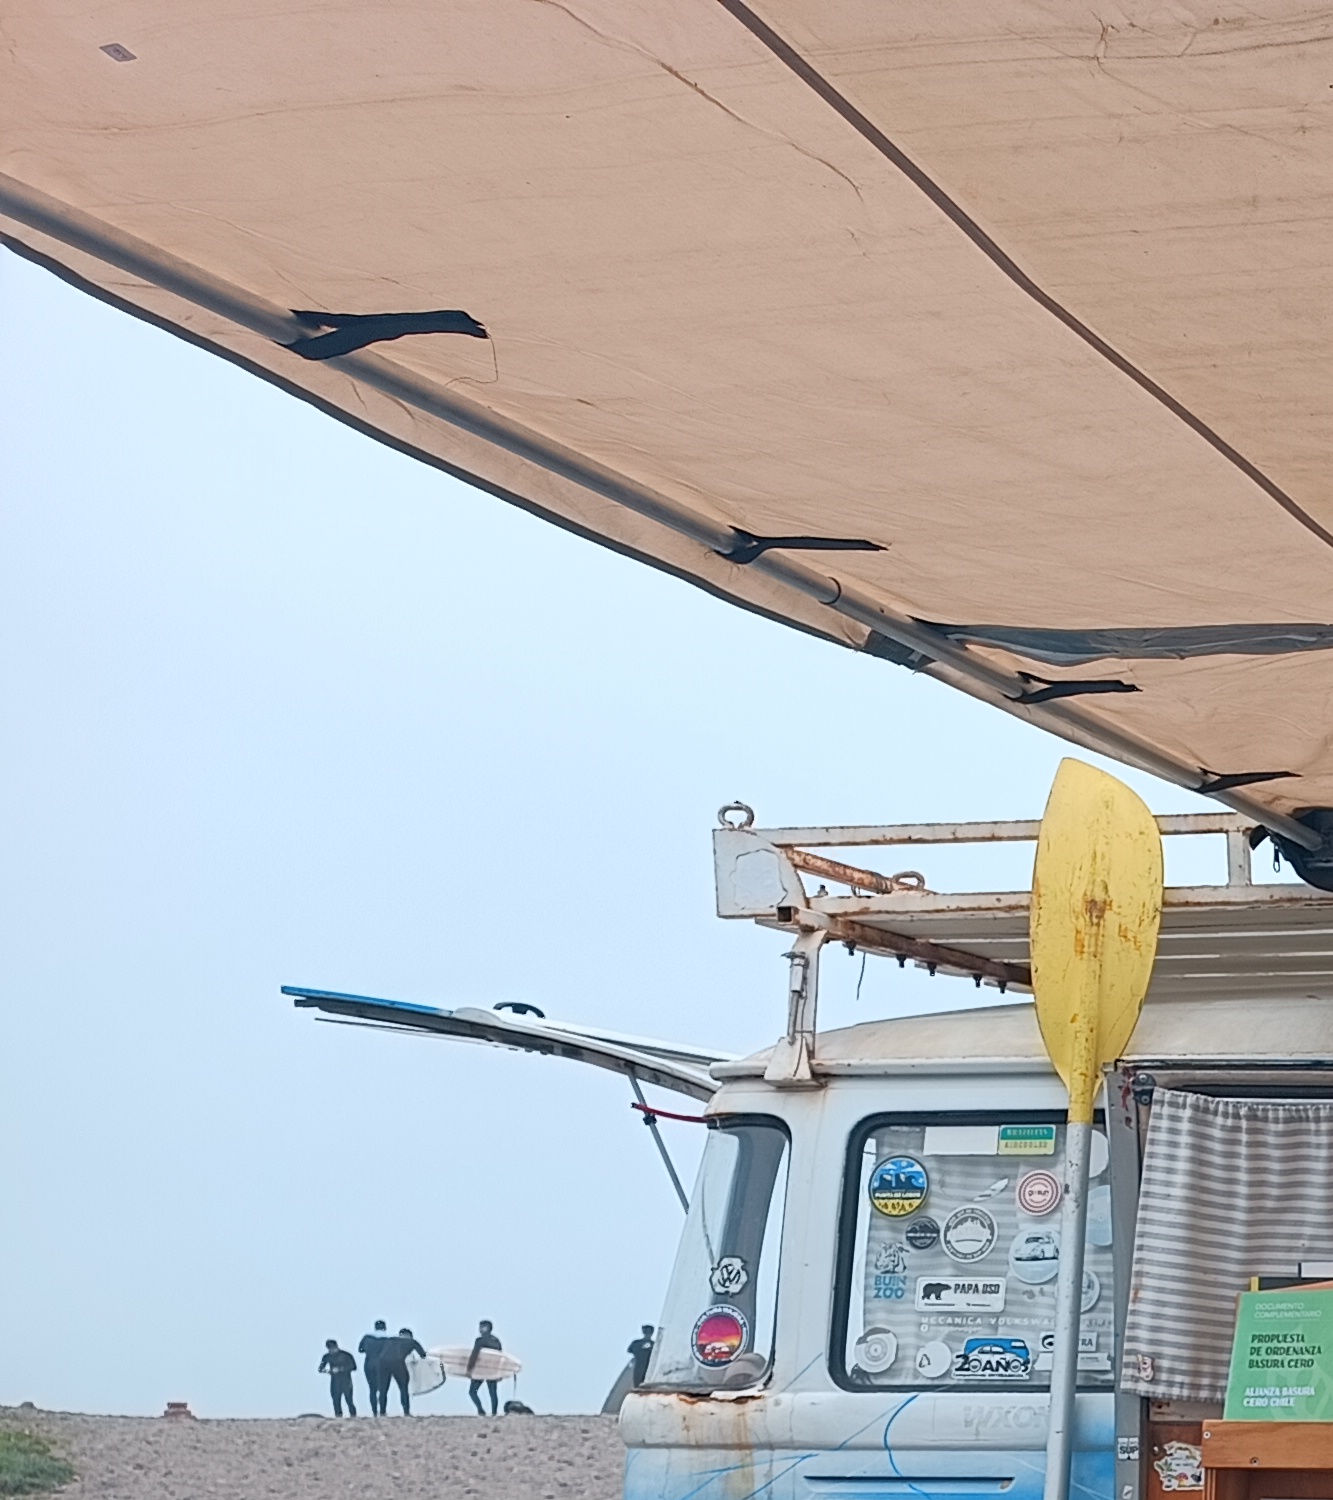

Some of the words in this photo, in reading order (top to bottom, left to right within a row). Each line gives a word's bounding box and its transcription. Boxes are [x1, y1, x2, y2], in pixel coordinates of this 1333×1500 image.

[874, 1275, 907, 1287] BUIN
[874, 1287, 905, 1300] ZOO
[953, 1283, 979, 1295] PAPA
[920, 1316, 983, 1325] MECANICA
[1251, 1333, 1306, 1344] PROPUESTA
[1249, 1346, 1263, 1357] DE
[1265, 1346, 1323, 1357] ORDENANZA
[1248, 1358, 1286, 1370] BASURA
[1287, 1358, 1315, 1370] CERO
[1244, 1386, 1281, 1398] ALIANZA
[1282, 1386, 1316, 1397] BASURA
[1243, 1397, 1269, 1408] CERO
[1271, 1397, 1296, 1408] CHILE
